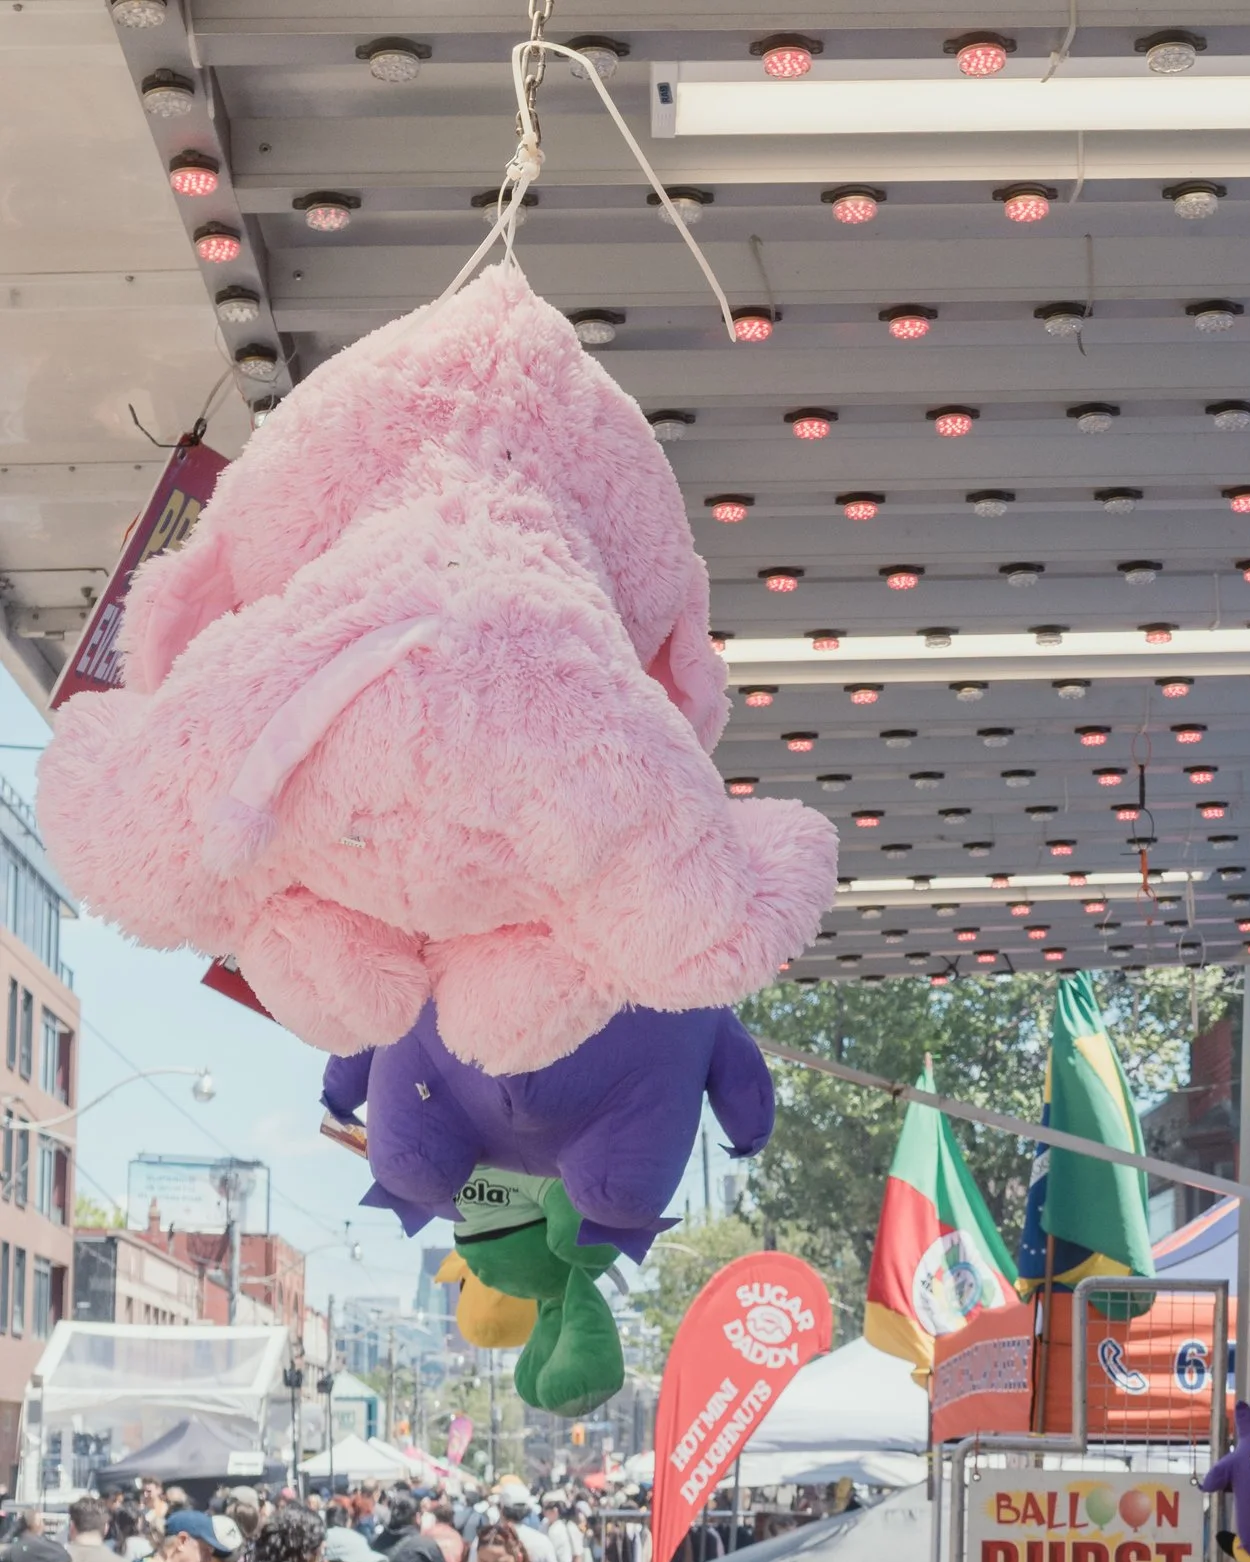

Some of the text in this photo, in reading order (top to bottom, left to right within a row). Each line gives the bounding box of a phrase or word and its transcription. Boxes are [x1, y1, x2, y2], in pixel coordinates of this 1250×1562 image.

[735, 1282, 815, 1333] SUGAR
[722, 1319, 800, 1369] DADDY
[669, 1378, 739, 1473] HOT MINI
[679, 1379, 773, 1506] DOUGHNUTS
[995, 1488, 1181, 1531] BALLOON
